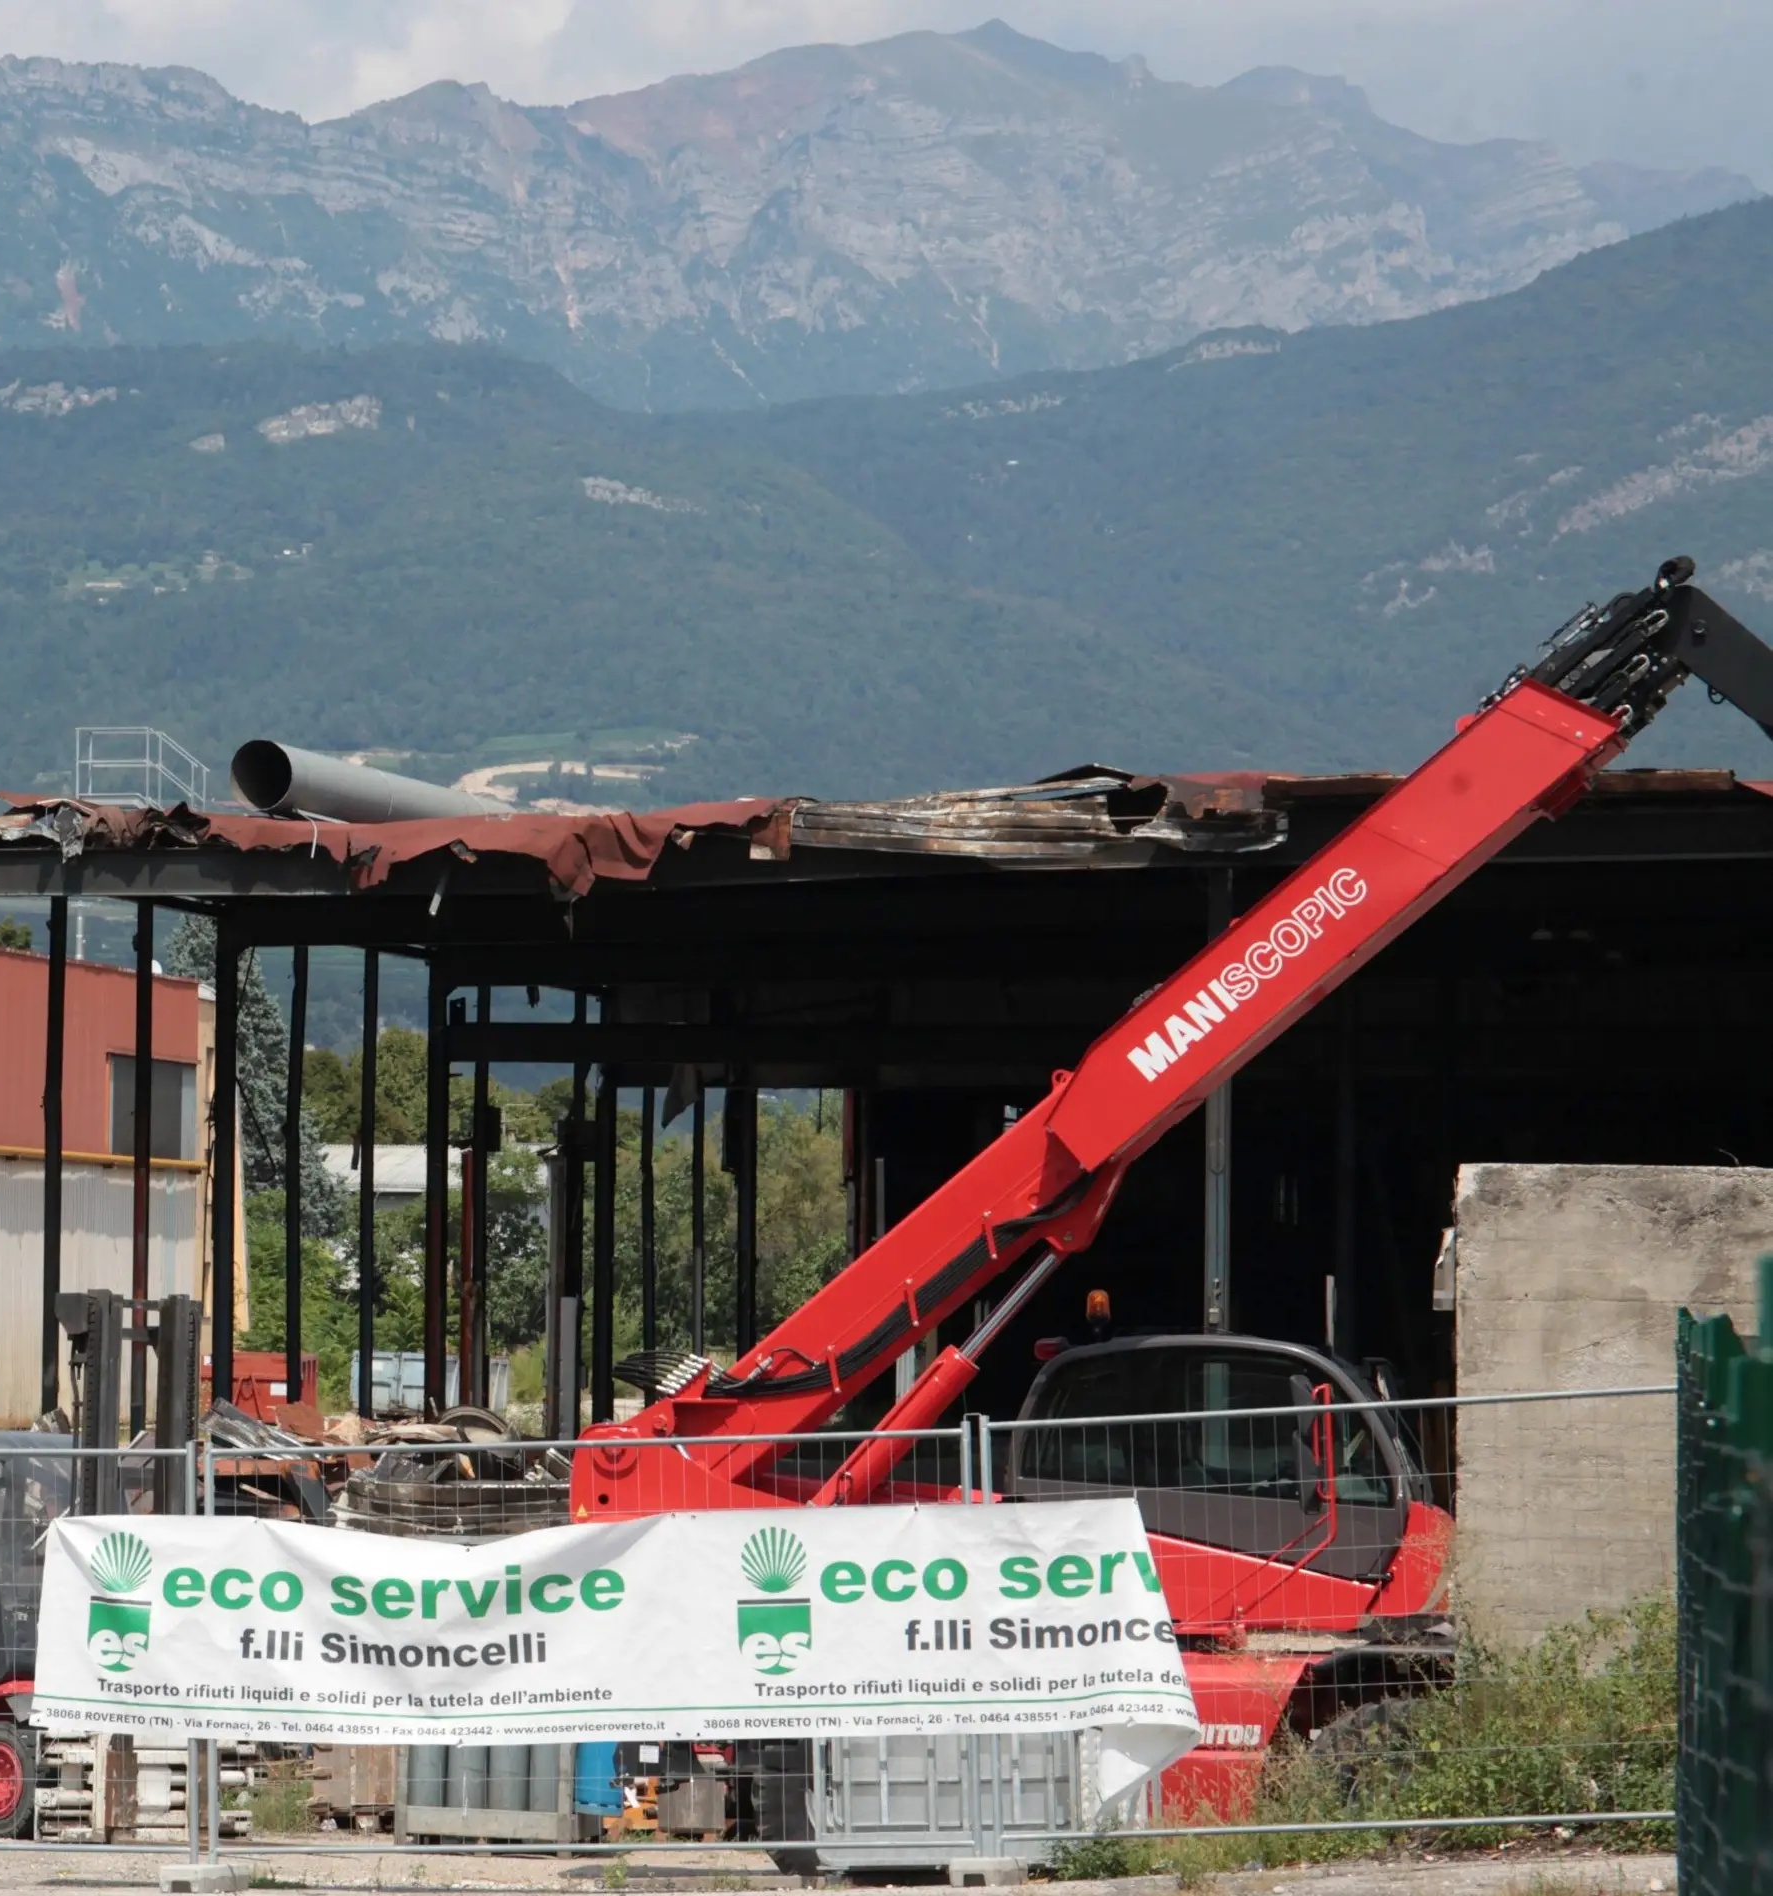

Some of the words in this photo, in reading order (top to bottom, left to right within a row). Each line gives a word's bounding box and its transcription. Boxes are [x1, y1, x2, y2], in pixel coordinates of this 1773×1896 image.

[1127, 868, 1367, 1083] MANISCOPIC
[163, 1568, 303, 1612] eco
[331, 1565, 625, 1619] service
[820, 1558, 968, 1603] eco
[240, 1628, 303, 1660] f.lli
[321, 1633, 545, 1667] Simoncelli
[905, 1619, 971, 1650] f.lli
[98, 1678, 180, 1698] Trasporto
[185, 1683, 235, 1700] rifiuti
[240, 1685, 294, 1704] liquidi
[299, 1691, 311, 1702] e
[316, 1690, 366, 1705] solidi
[372, 1695, 404, 1709] per
[407, 1693, 424, 1708] la
[428, 1692, 484, 1708] tutela
[489, 1686, 613, 1708] dell'ambiente
[754, 1682, 847, 1700] Trasporto
[853, 1679, 903, 1695] rifiuti
[908, 1678, 966, 1697] liquidi
[971, 1680, 984, 1692] e
[989, 1676, 1042, 1692] solidi
[1047, 1678, 1078, 1695] per
[1083, 1673, 1096, 1688] la
[1099, 1668, 1154, 1685] tutela
[46, 1707, 82, 1721] 38068
[84, 1711, 146, 1726] ROVERETO
[149, 1716, 174, 1729] (TN)
[183, 1717, 203, 1728] Via
[205, 1719, 254, 1732] Fornaci,
[257, 1720, 272, 1731] 26
[280, 1721, 302, 1732] Tel.
[304, 1722, 334, 1733] 0464
[336, 1724, 380, 1735] 438551
[391, 1726, 413, 1736] Fax
[416, 1727, 446, 1736] 0464
[450, 1725, 493, 1736] 423442
[503, 1720, 666, 1735] www.ecoservicerovereto.it
[703, 1718, 741, 1730] 38068
[744, 1717, 812, 1729] ROVERETO
[815, 1716, 842, 1729] (TN)
[852, 1716, 873, 1726] Via
[876, 1714, 924, 1726] Fornaci,
[927, 1713, 943, 1725] 26
[954, 1713, 976, 1724] Tel.
[979, 1712, 1011, 1724] 0464
[1013, 1711, 1058, 1723] 438551
[1069, 1710, 1088, 1720] Fax
[1089, 1703, 1114, 1717] 0464
[1116, 1703, 1164, 1714] 423442
